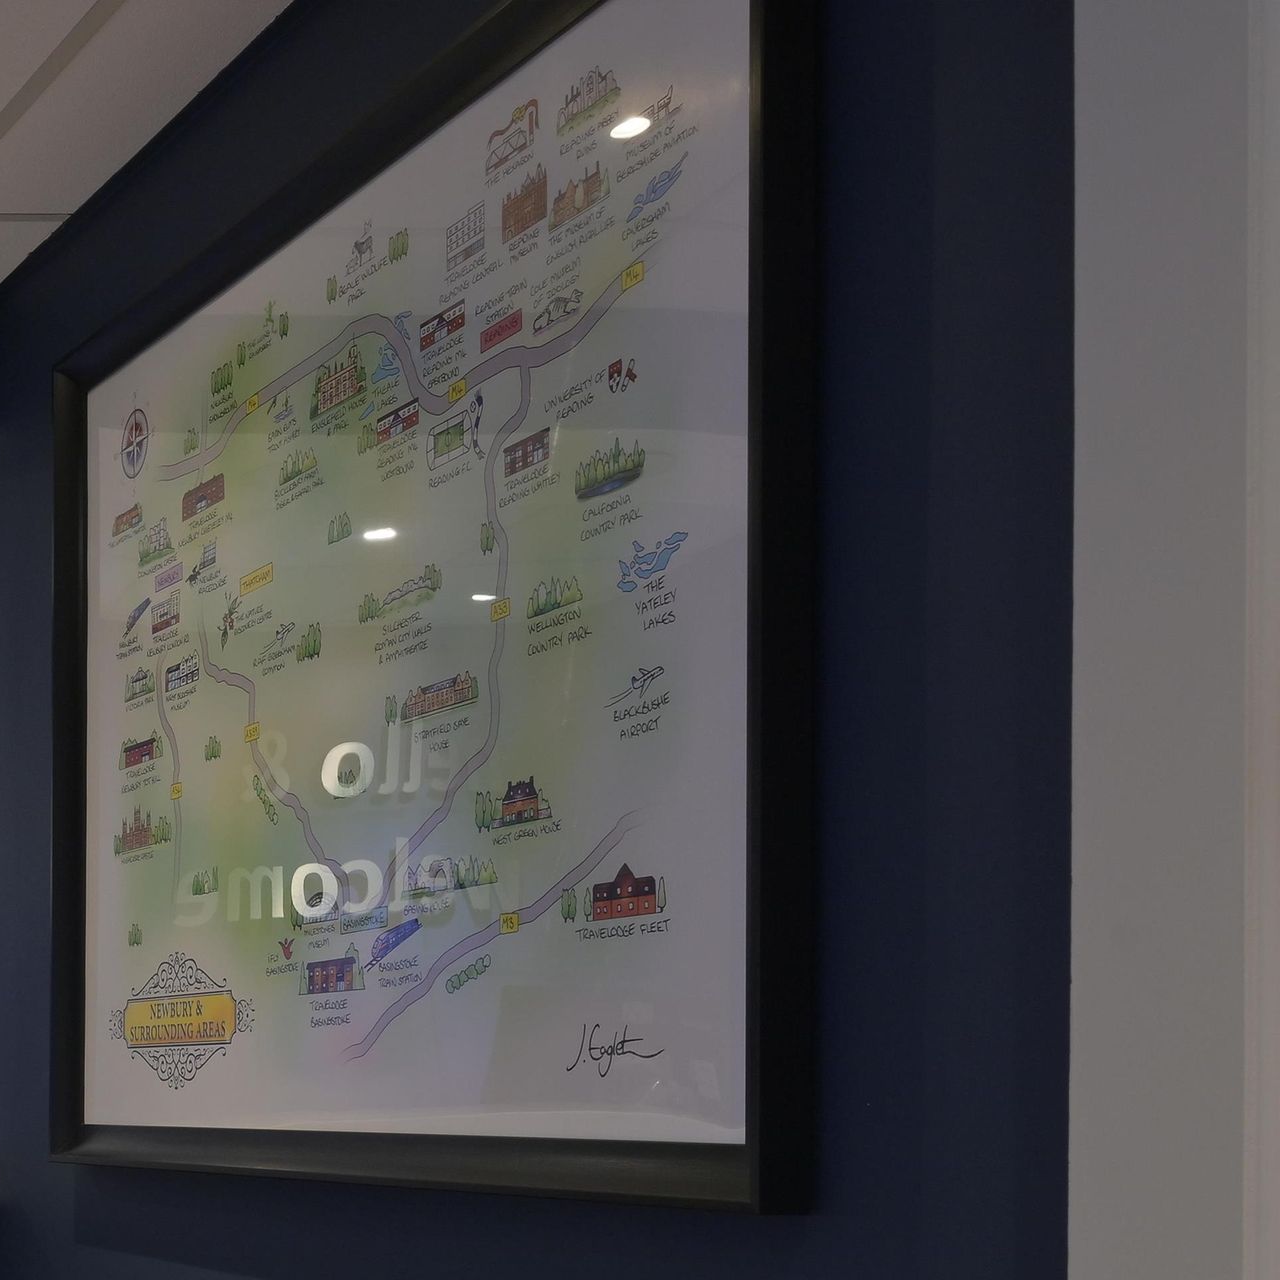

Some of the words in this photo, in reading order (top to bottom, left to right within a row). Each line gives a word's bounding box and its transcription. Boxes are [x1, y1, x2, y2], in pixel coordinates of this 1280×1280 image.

[664, 119, 676, 137] OF
[548, 232, 562, 246] THE
[595, 206, 607, 219] OF
[543, 374, 594, 413] UNIVERSITY
[594, 368, 608, 384] OF
[555, 392, 595, 423] READING
[503, 463, 550, 492] TRAVELODGE
[498, 487, 530, 509] READING
[582, 493, 632, 522] CALIFORNIA
[580, 517, 618, 541] COUNTRY
[618, 507, 644, 527] PARK
[642, 574, 666, 594] THE
[492, 601, 508, 619] A33
[635, 588, 677, 616] YATELEY
[382, 610, 423, 636] SILCHESTER
[527, 608, 583, 634] WELLINGTON
[642, 610, 677, 631] LAKES
[527, 635, 564, 657] COUNTRY
[567, 625, 593, 645] PARK
[613, 690, 671, 723] BLACKBUSHE
[619, 716, 662, 741] AIRPORT
[492, 832, 513, 847] WEST
[513, 823, 539, 842] GREEN
[539, 818, 563, 835] HOUSE
[501, 915, 515, 930] M3
[575, 922, 636, 942] TRAVELODGE
[639, 918, 672, 935] FLEET
[150, 1000, 194, 1020] NEWBURY
[195, 1000, 203, 1017] &
[129, 1023, 194, 1043] SURROUNDING
[194, 1020, 226, 1039] AREAS
